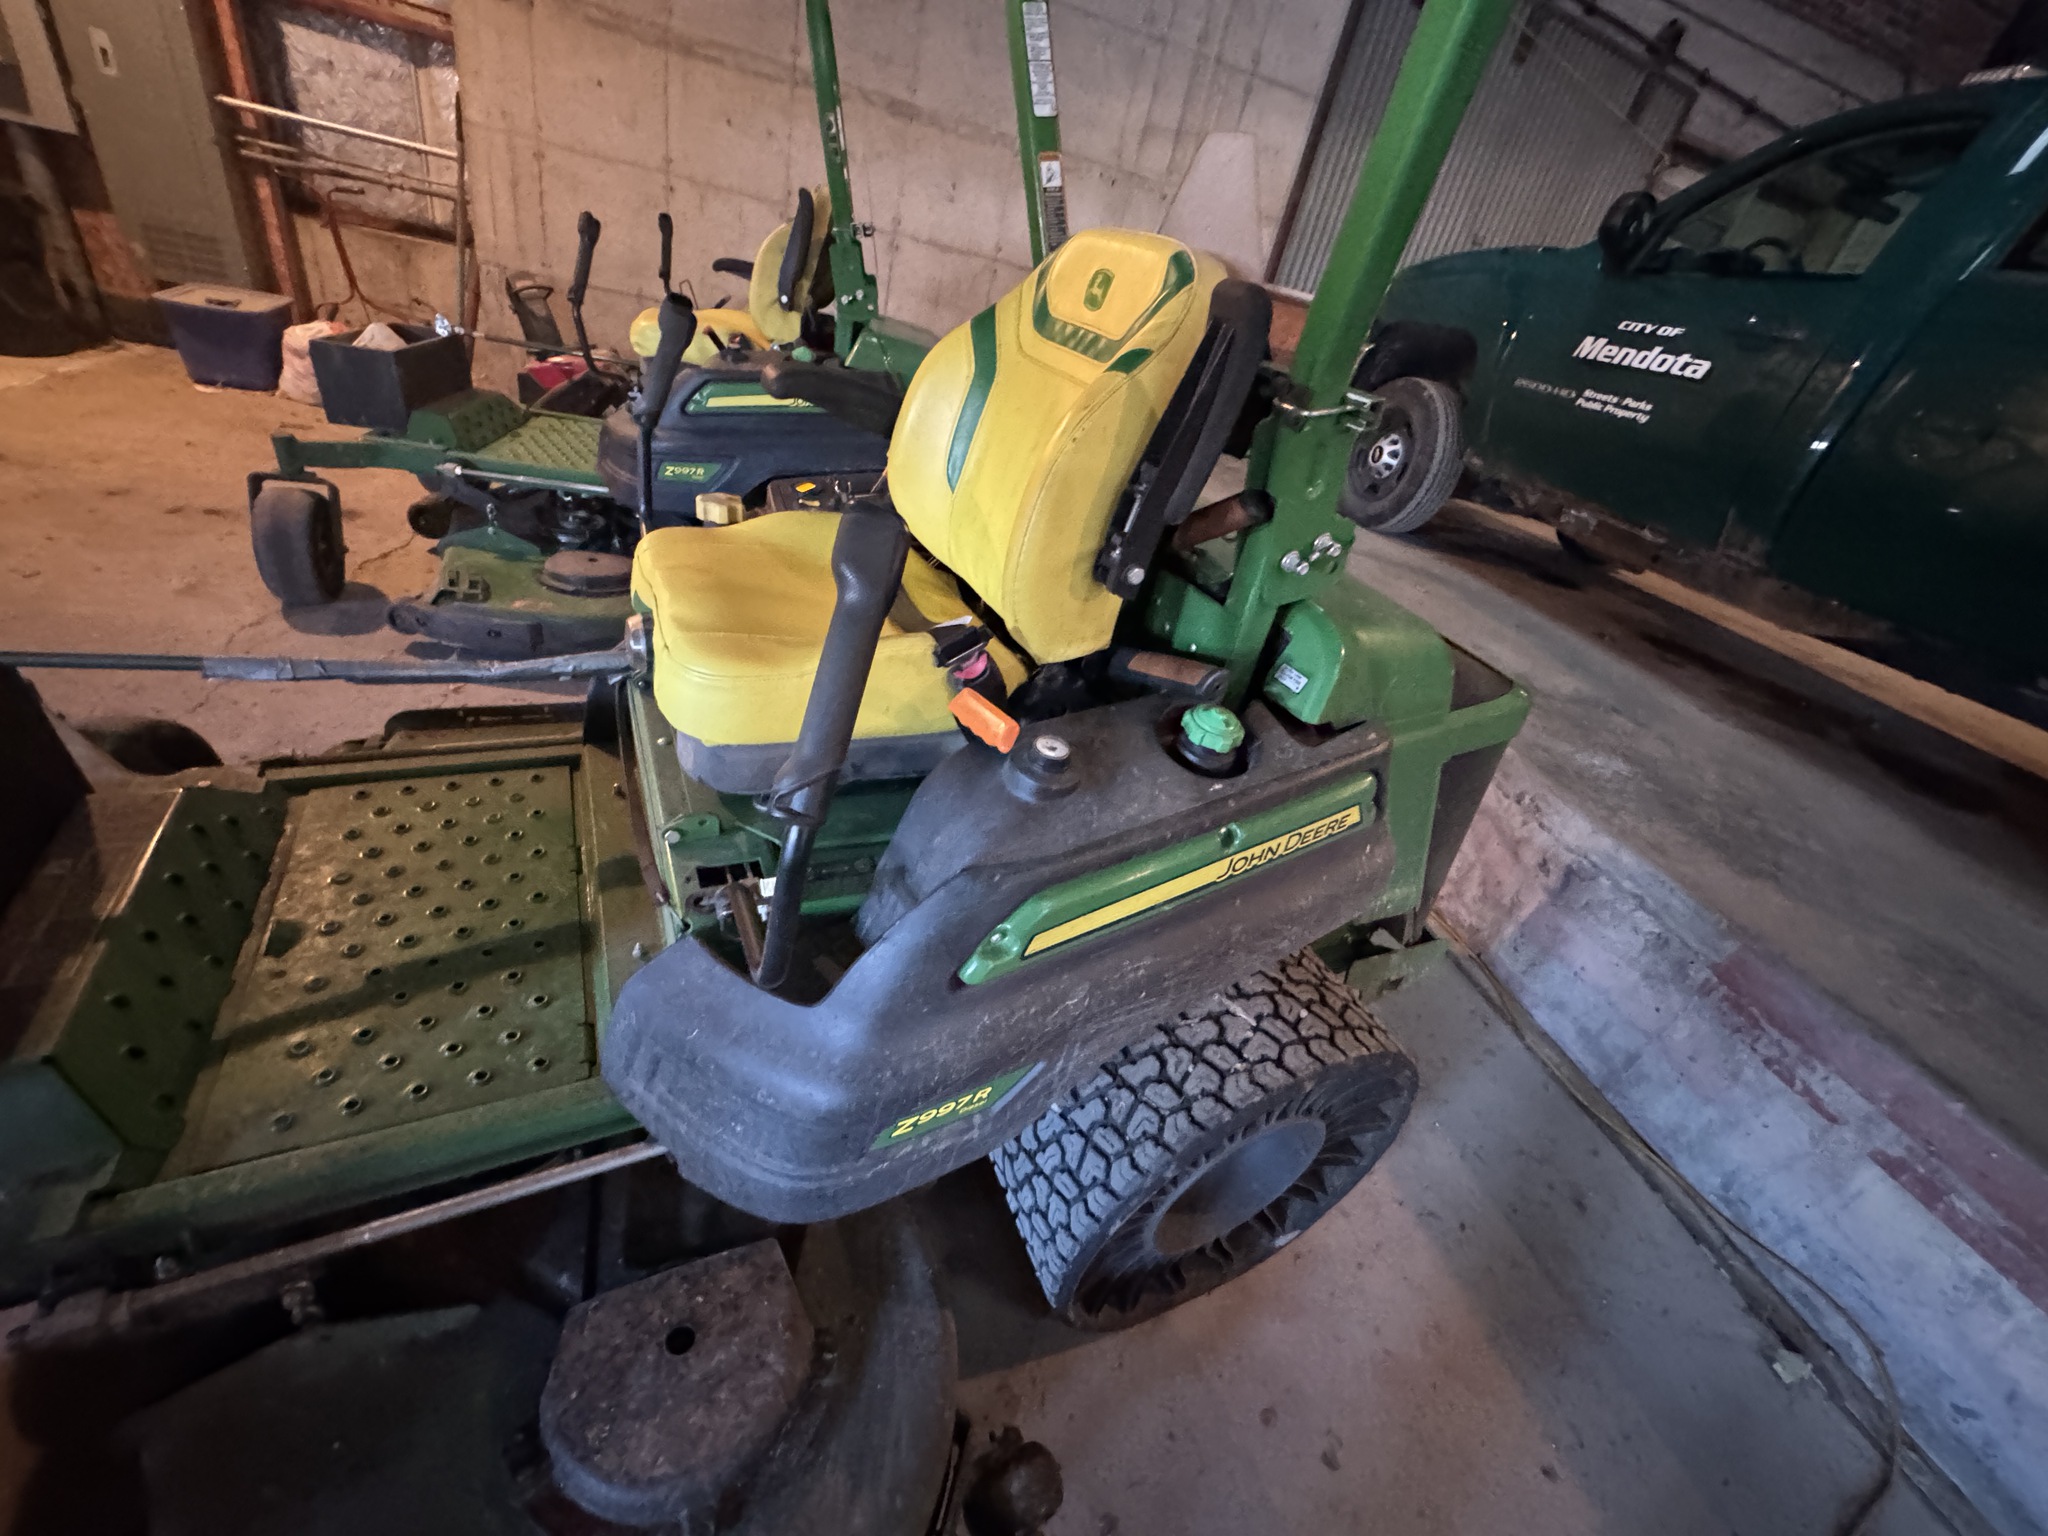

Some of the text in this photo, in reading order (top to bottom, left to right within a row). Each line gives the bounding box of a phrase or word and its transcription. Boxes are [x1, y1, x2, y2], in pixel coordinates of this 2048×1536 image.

[1617, 320, 1686, 338] CITY OF
[1572, 335, 1712, 380] Mendota
[1575, 397, 1650, 424] Public Property
[1582, 388, 1654, 411] Streets Parks
[664, 465, 705, 476] Z997R
[1216, 813, 1352, 881] JOHN DEERE
[891, 1086, 993, 1138] Z997R
